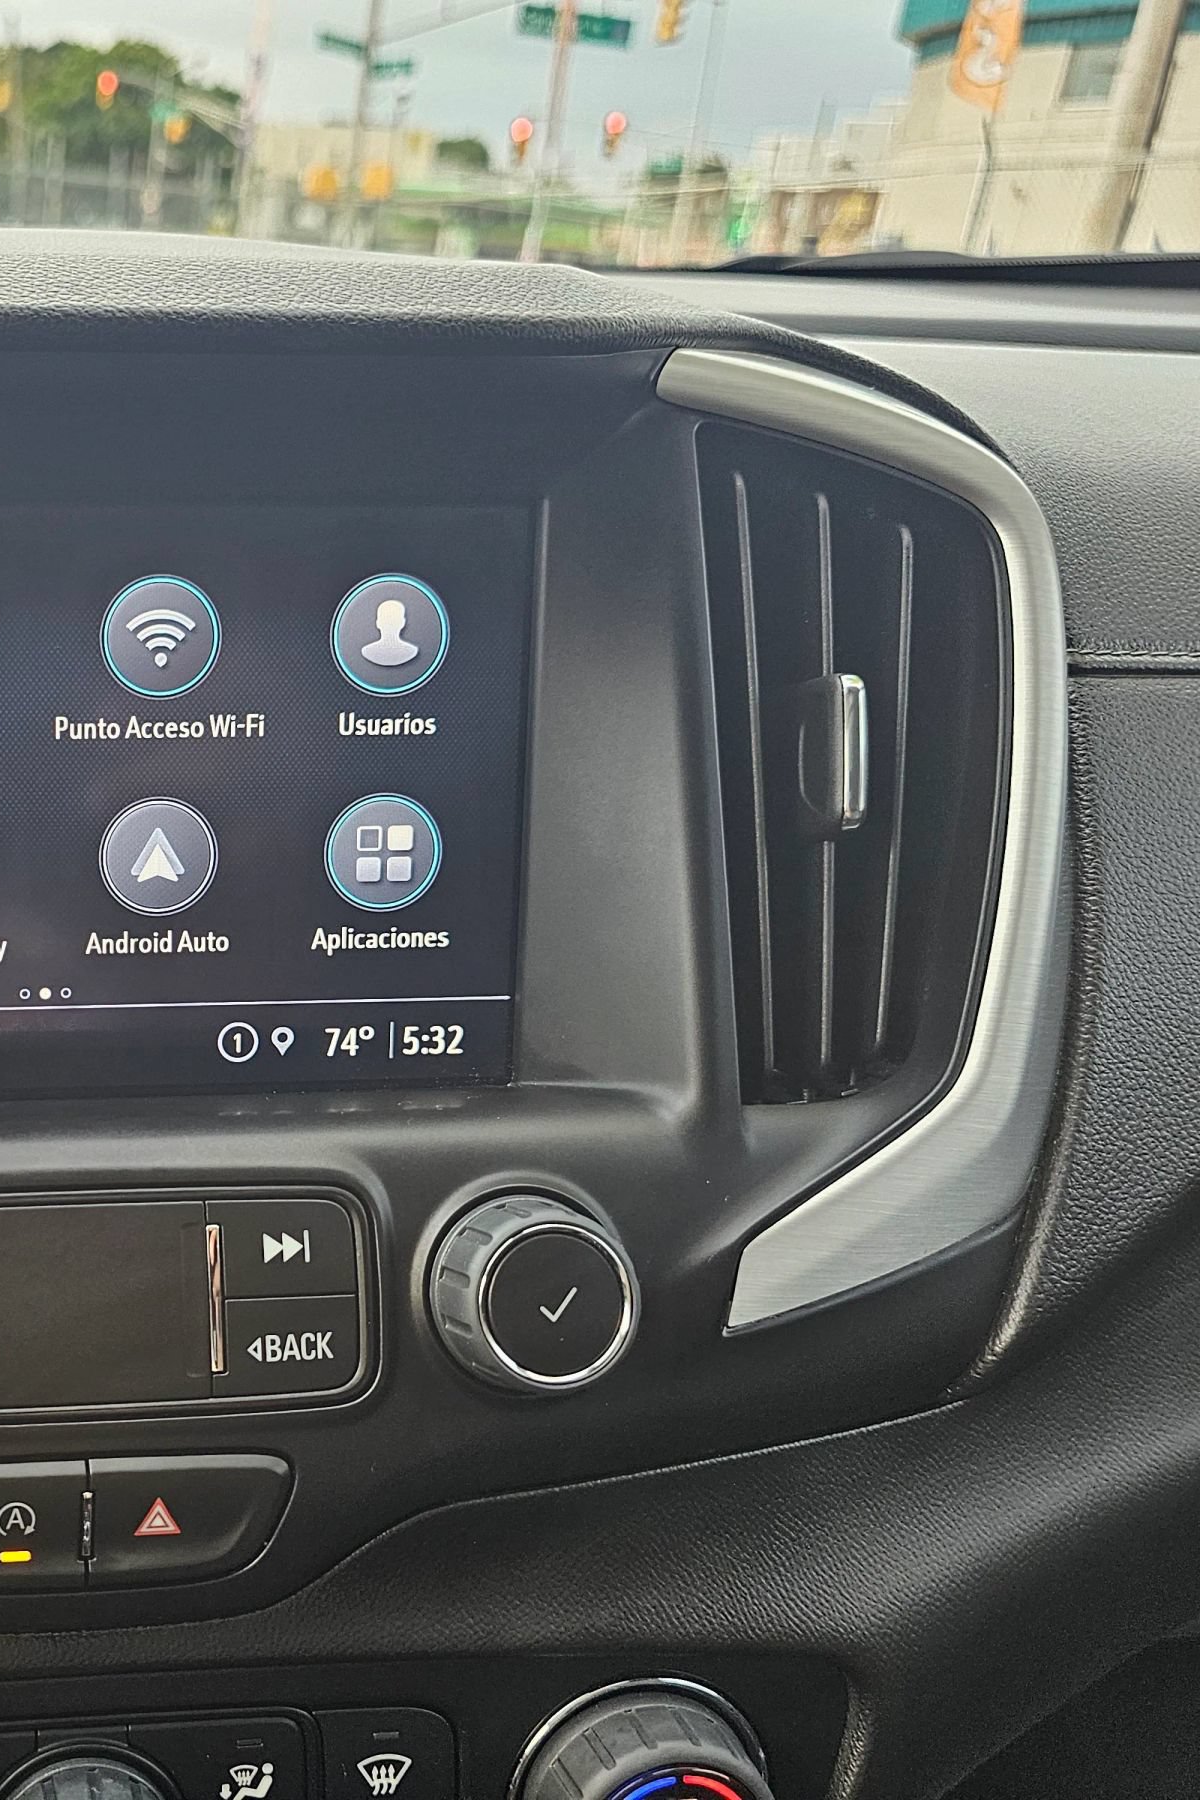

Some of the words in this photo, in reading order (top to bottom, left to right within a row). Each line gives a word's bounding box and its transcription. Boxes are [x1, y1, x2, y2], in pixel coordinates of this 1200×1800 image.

[54, 715, 121, 740] Punto
[124, 714, 205, 740] Acceso
[209, 713, 265, 739] Wi-Fi
[338, 711, 437, 737] Usuarios
[85, 929, 174, 955] Android
[176, 929, 230, 954] Auto
[310, 926, 450, 957] Aplicaciones
[232, 1032, 243, 1054] 1
[324, 1025, 375, 1057] 74°
[402, 1024, 464, 1056] 5:32
[265, 1331, 335, 1363] BACK
